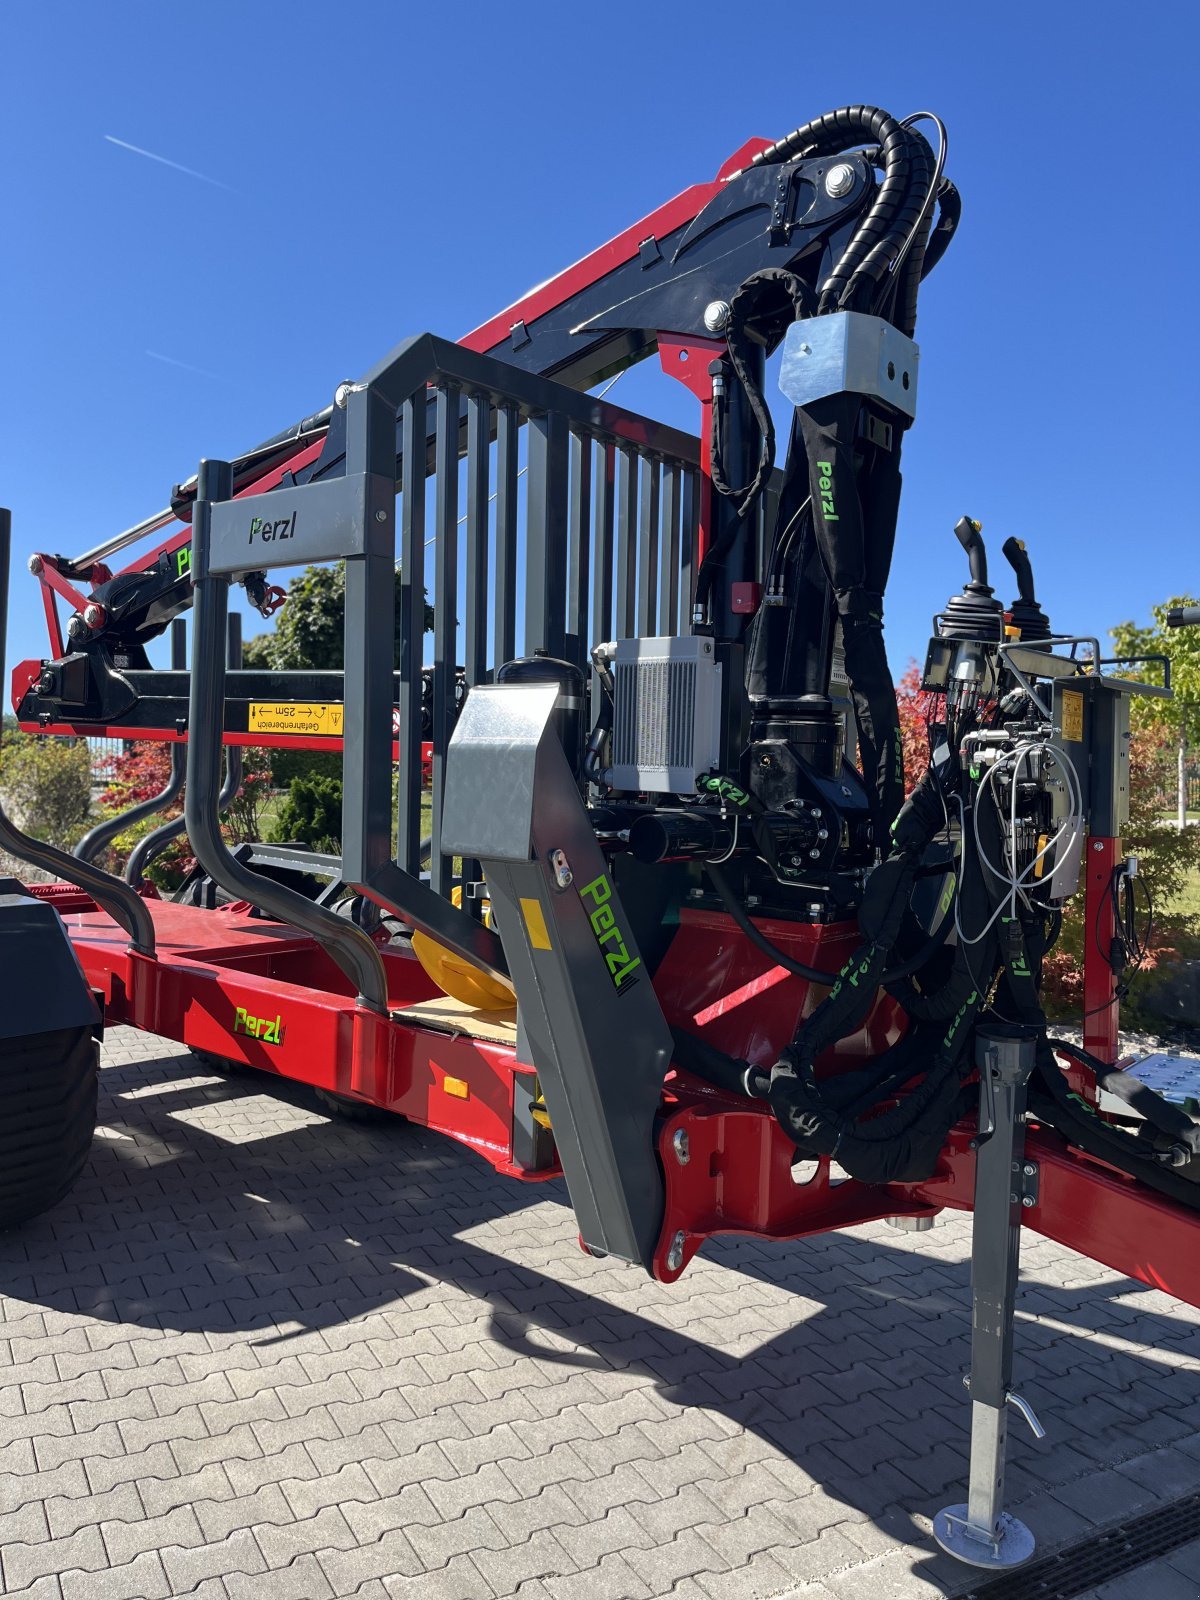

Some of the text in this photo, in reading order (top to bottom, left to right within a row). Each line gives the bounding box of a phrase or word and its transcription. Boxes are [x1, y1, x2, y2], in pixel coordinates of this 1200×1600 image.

[816, 461, 839, 521] Perzl
[248, 511, 297, 545] Perzl
[257, 721, 320, 732] Gefahrenbereich
[275, 707, 296, 717] 25m
[697, 775, 751, 806] erzl
[580, 873, 641, 988] Perzl
[234, 1006, 281, 1045] Perzl
